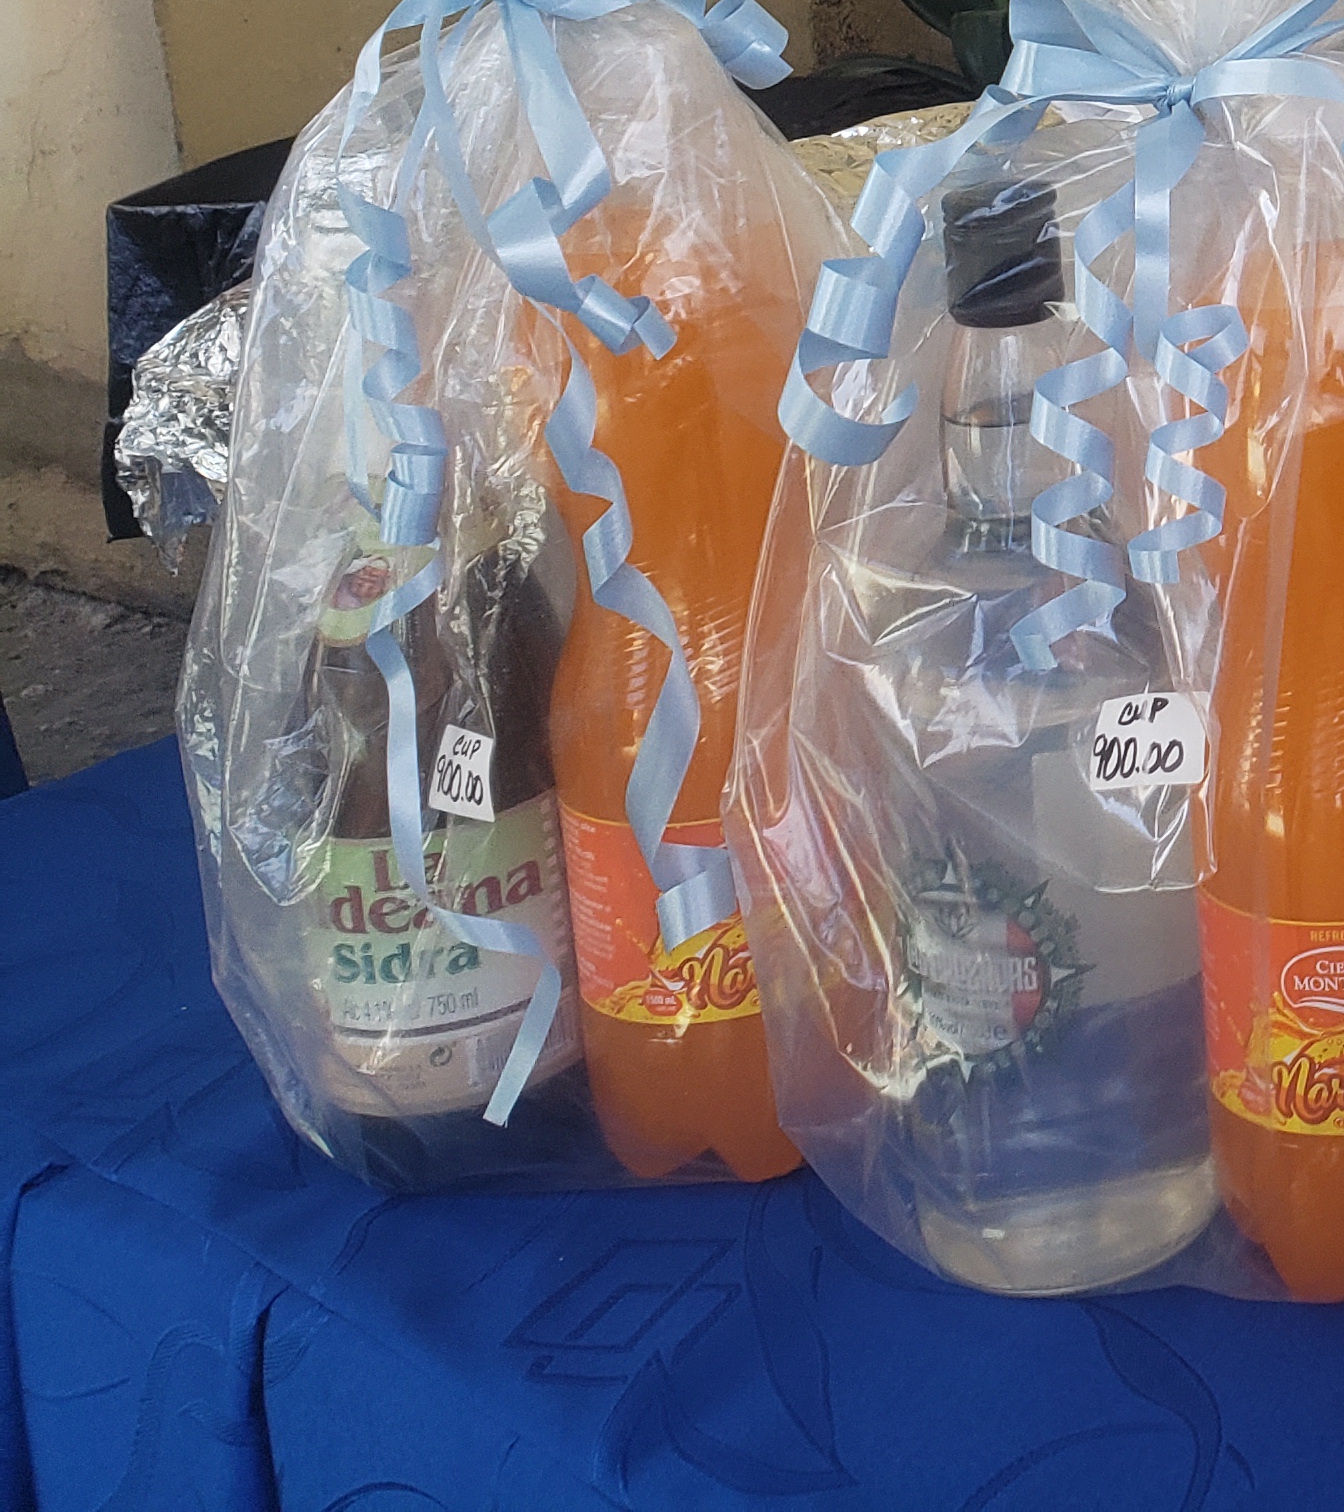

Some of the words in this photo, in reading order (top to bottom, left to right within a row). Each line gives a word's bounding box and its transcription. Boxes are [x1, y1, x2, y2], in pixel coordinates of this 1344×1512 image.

[1118, 697, 1169, 725] CUP
[453, 735, 481, 760] CUP
[1093, 733, 1184, 781] 900.00
[437, 754, 483, 805] 900.00
[333, 941, 481, 985] Sidra
[427, 993, 456, 1016] 750
[461, 987, 479, 1010] ml
